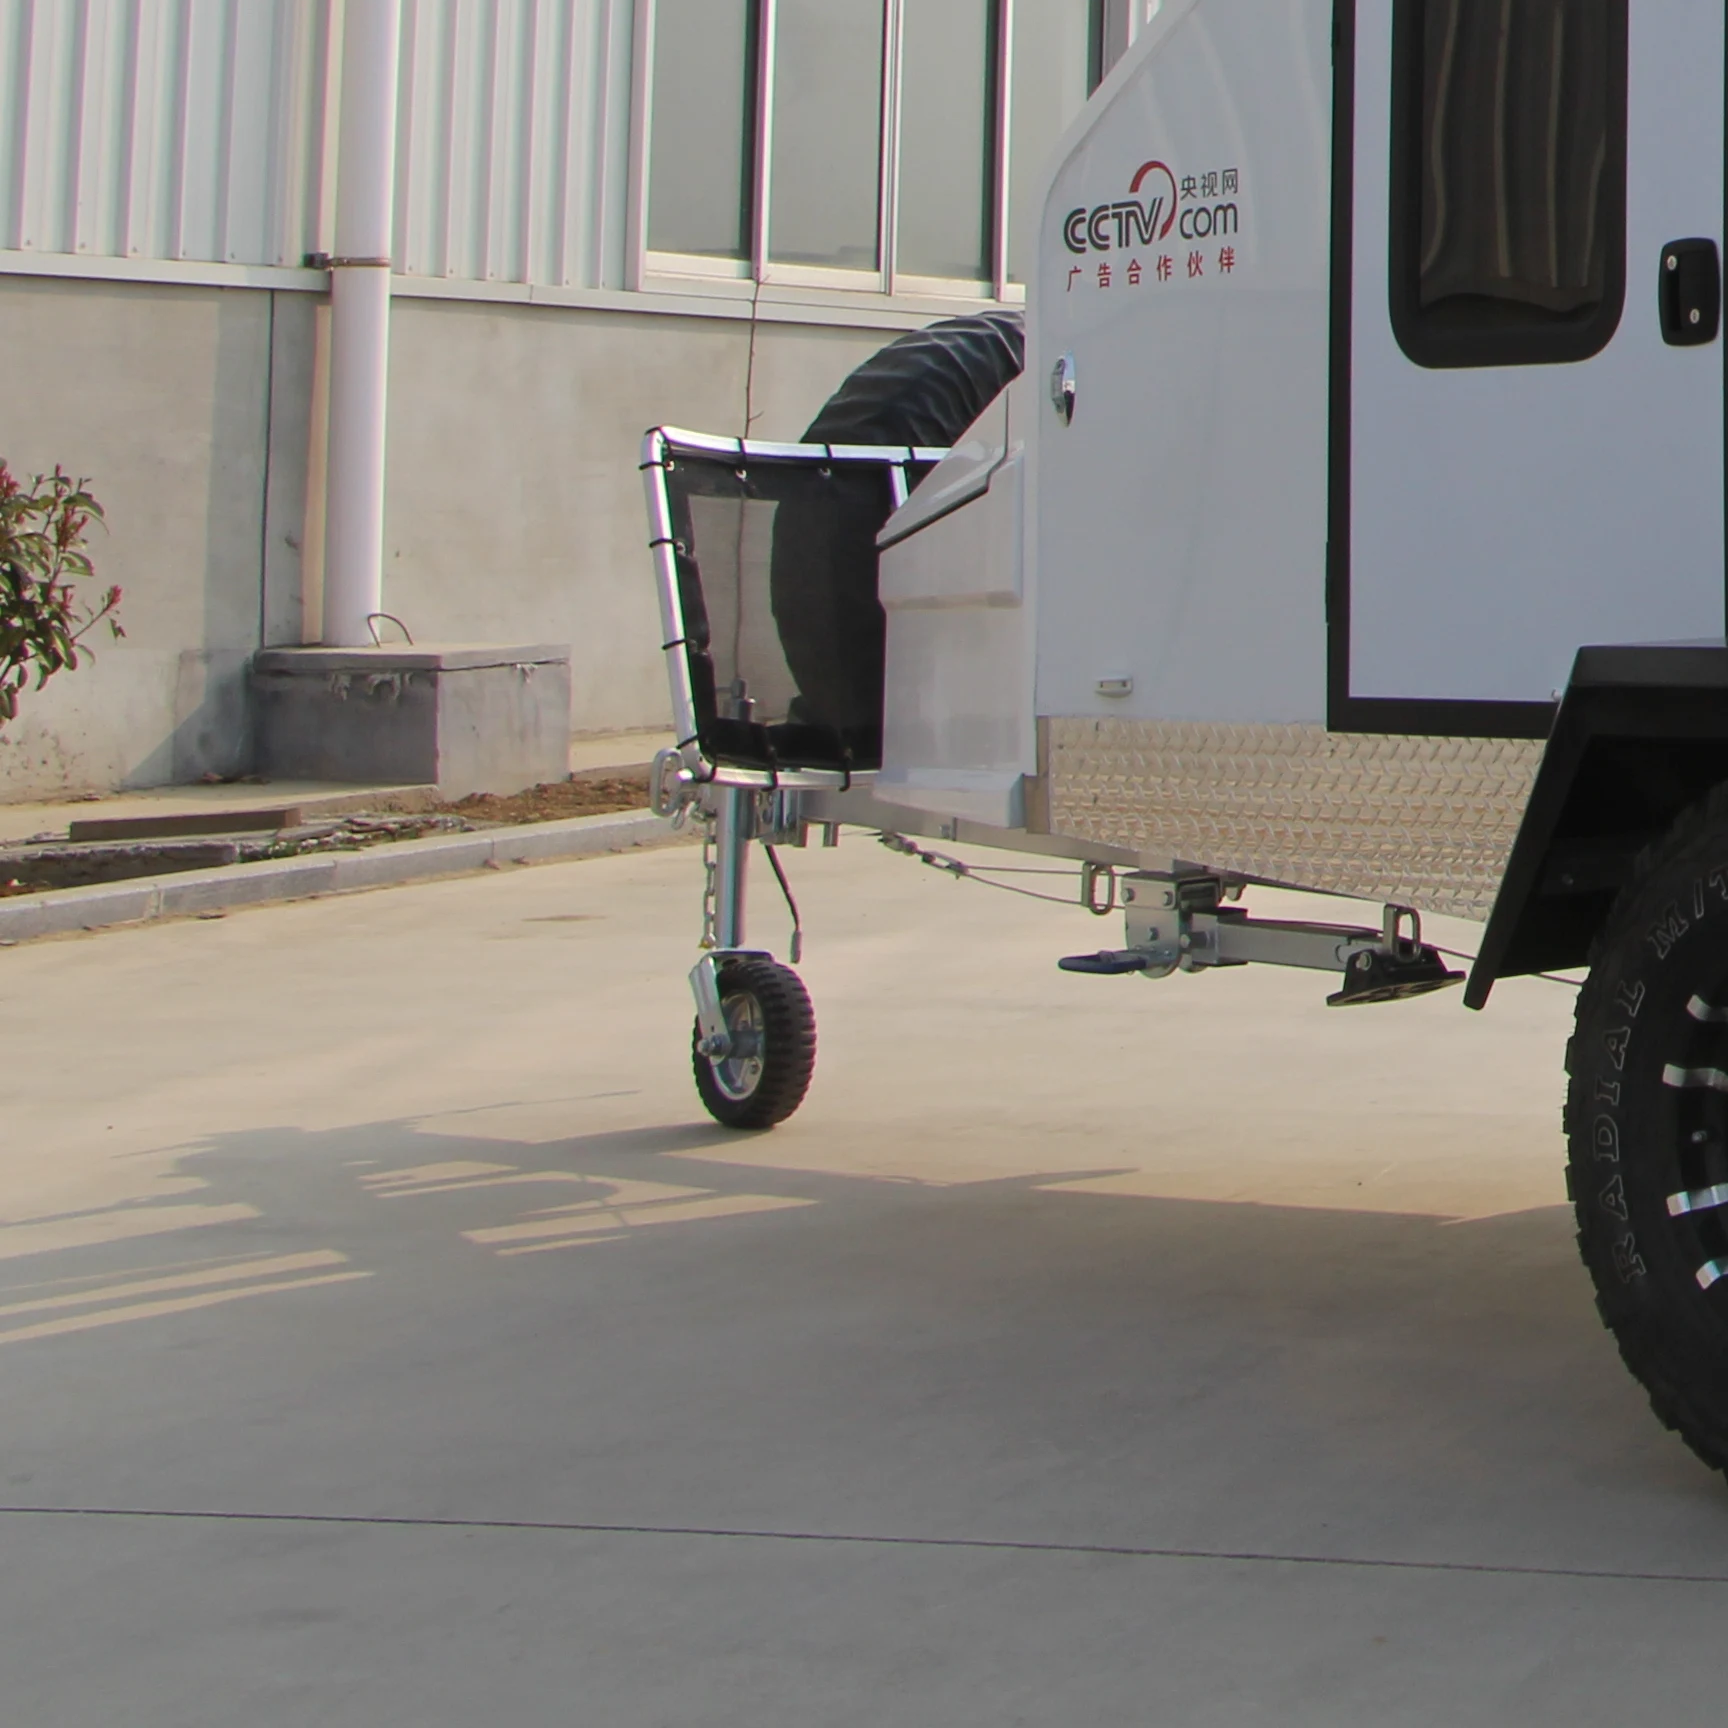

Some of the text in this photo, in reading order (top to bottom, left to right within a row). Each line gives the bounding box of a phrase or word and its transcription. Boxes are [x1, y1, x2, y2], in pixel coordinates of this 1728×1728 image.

[1180, 168, 1239, 200] 央视网
[1063, 196, 1164, 254] CCTV
[1066, 246, 1236, 293] 广告合作伙伴
[1592, 979, 1646, 1284] RADIAL
